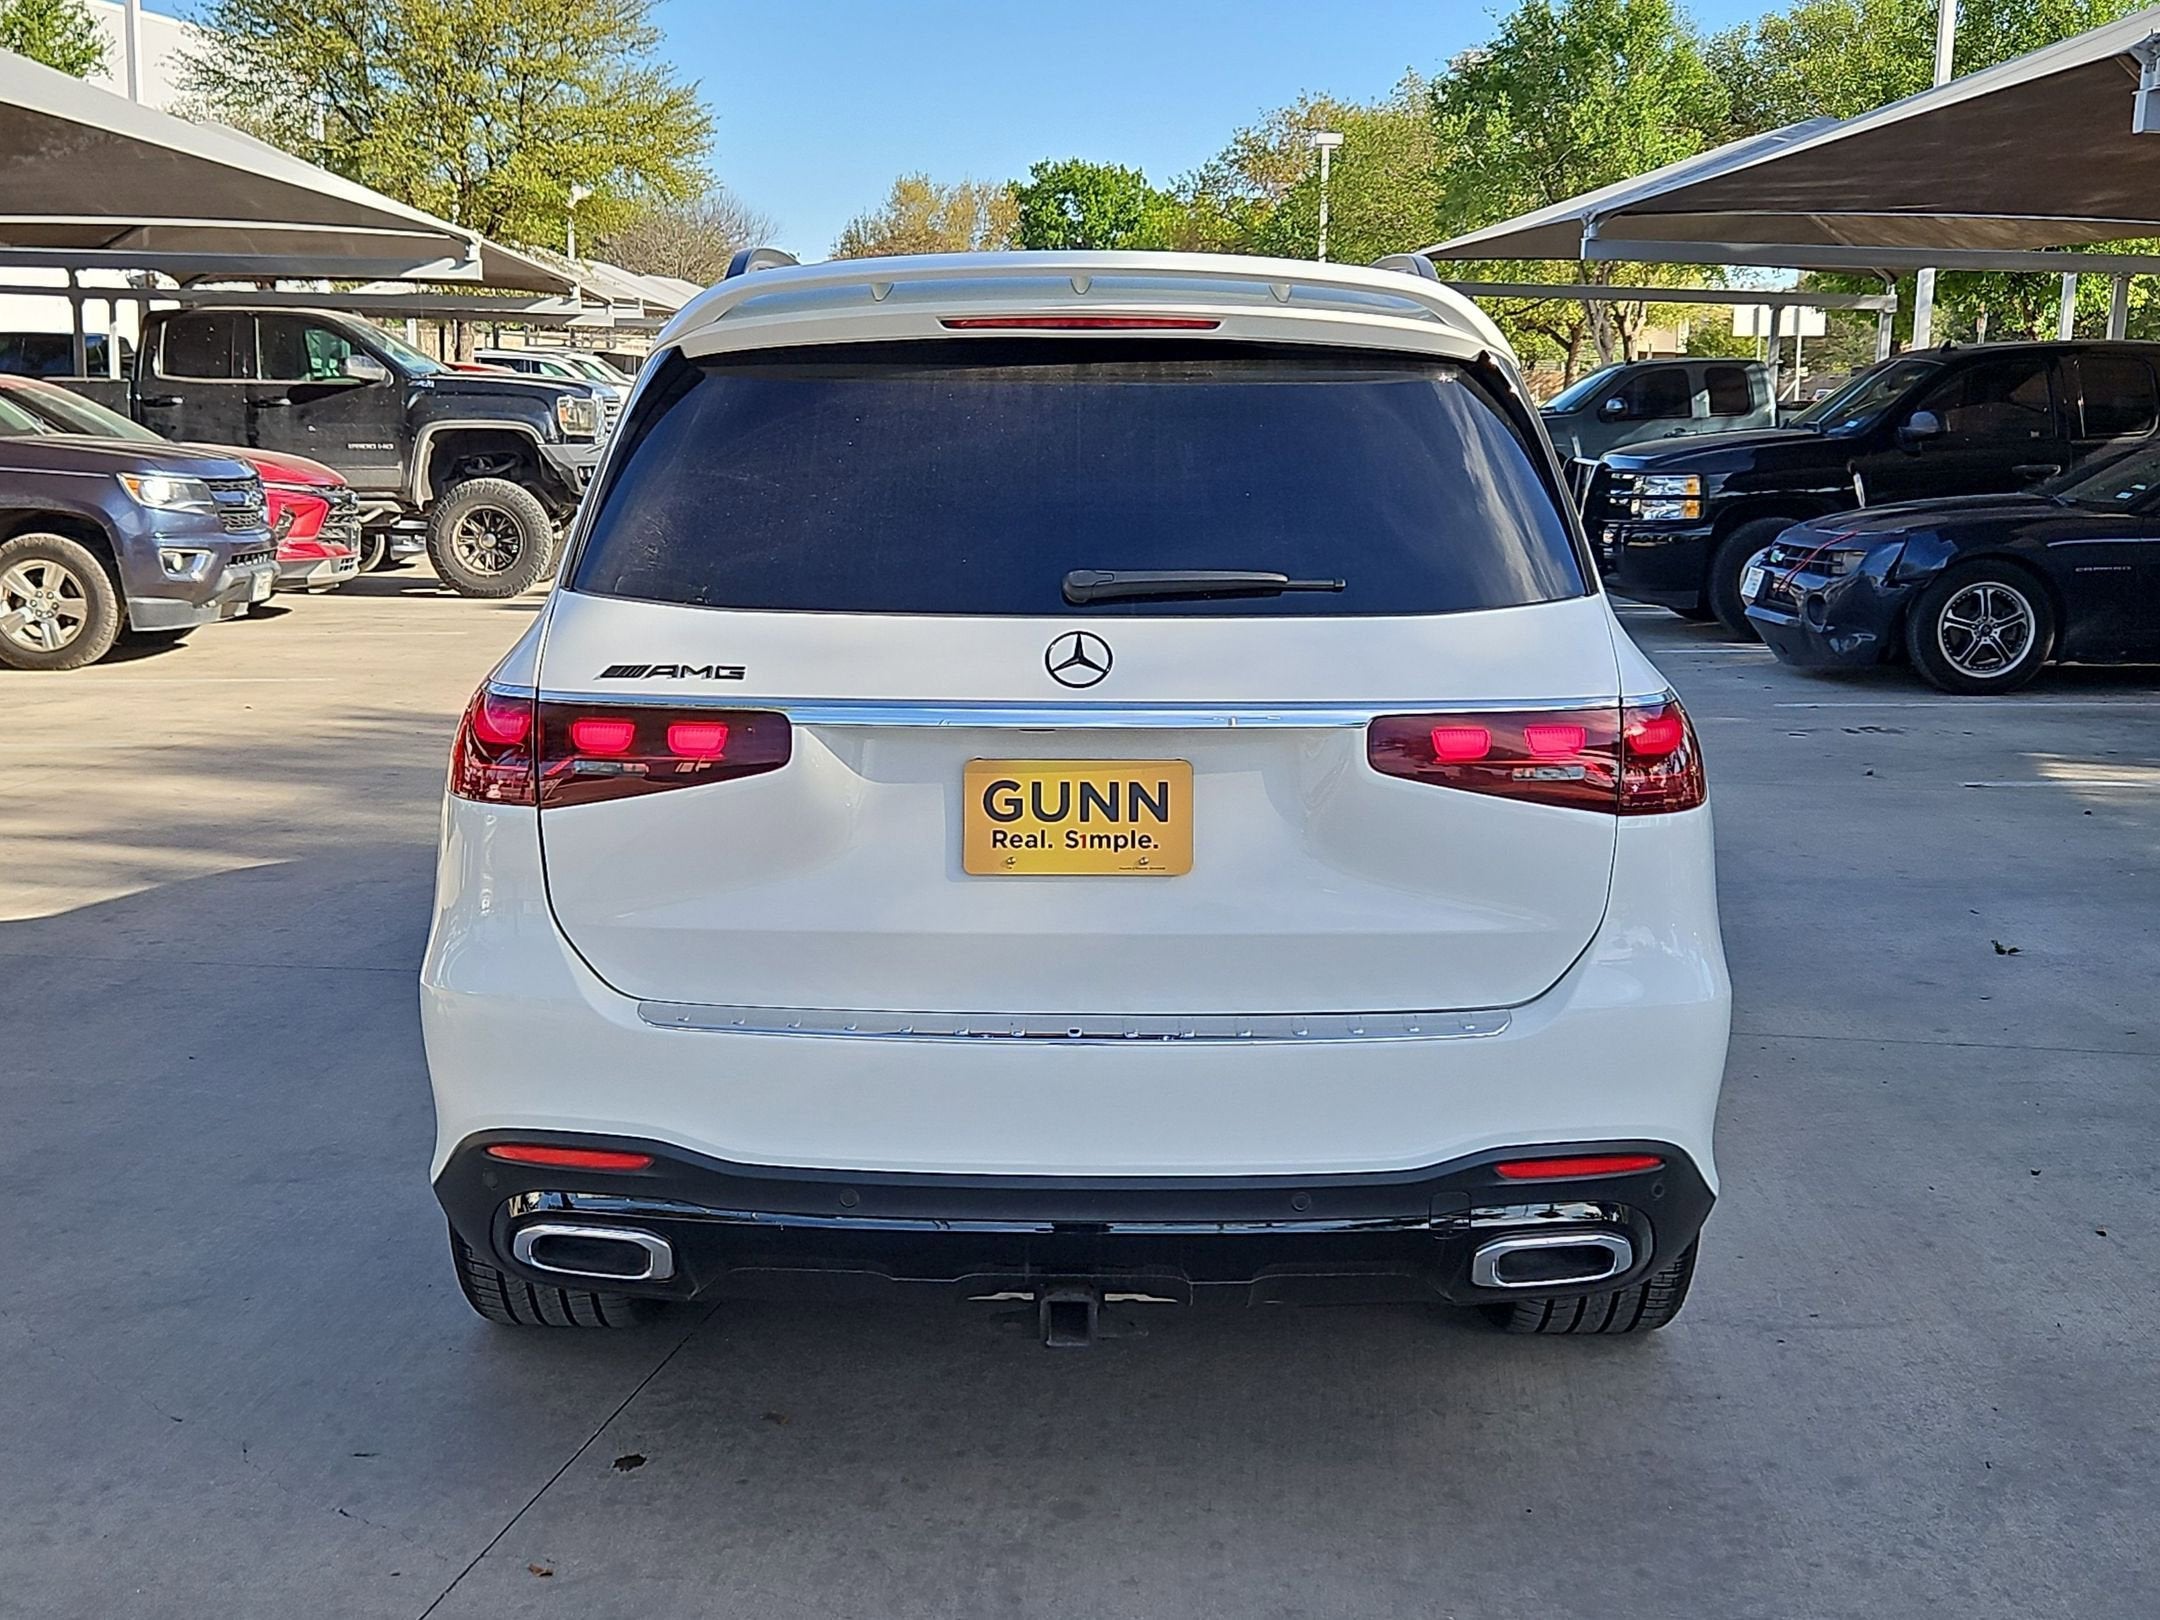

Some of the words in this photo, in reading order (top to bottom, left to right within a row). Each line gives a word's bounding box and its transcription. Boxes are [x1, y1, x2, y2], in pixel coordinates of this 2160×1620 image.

[640, 664, 746, 680] AMG
[982, 779, 1169, 823] GUNN
[991, 829, 1053, 849] Real.
